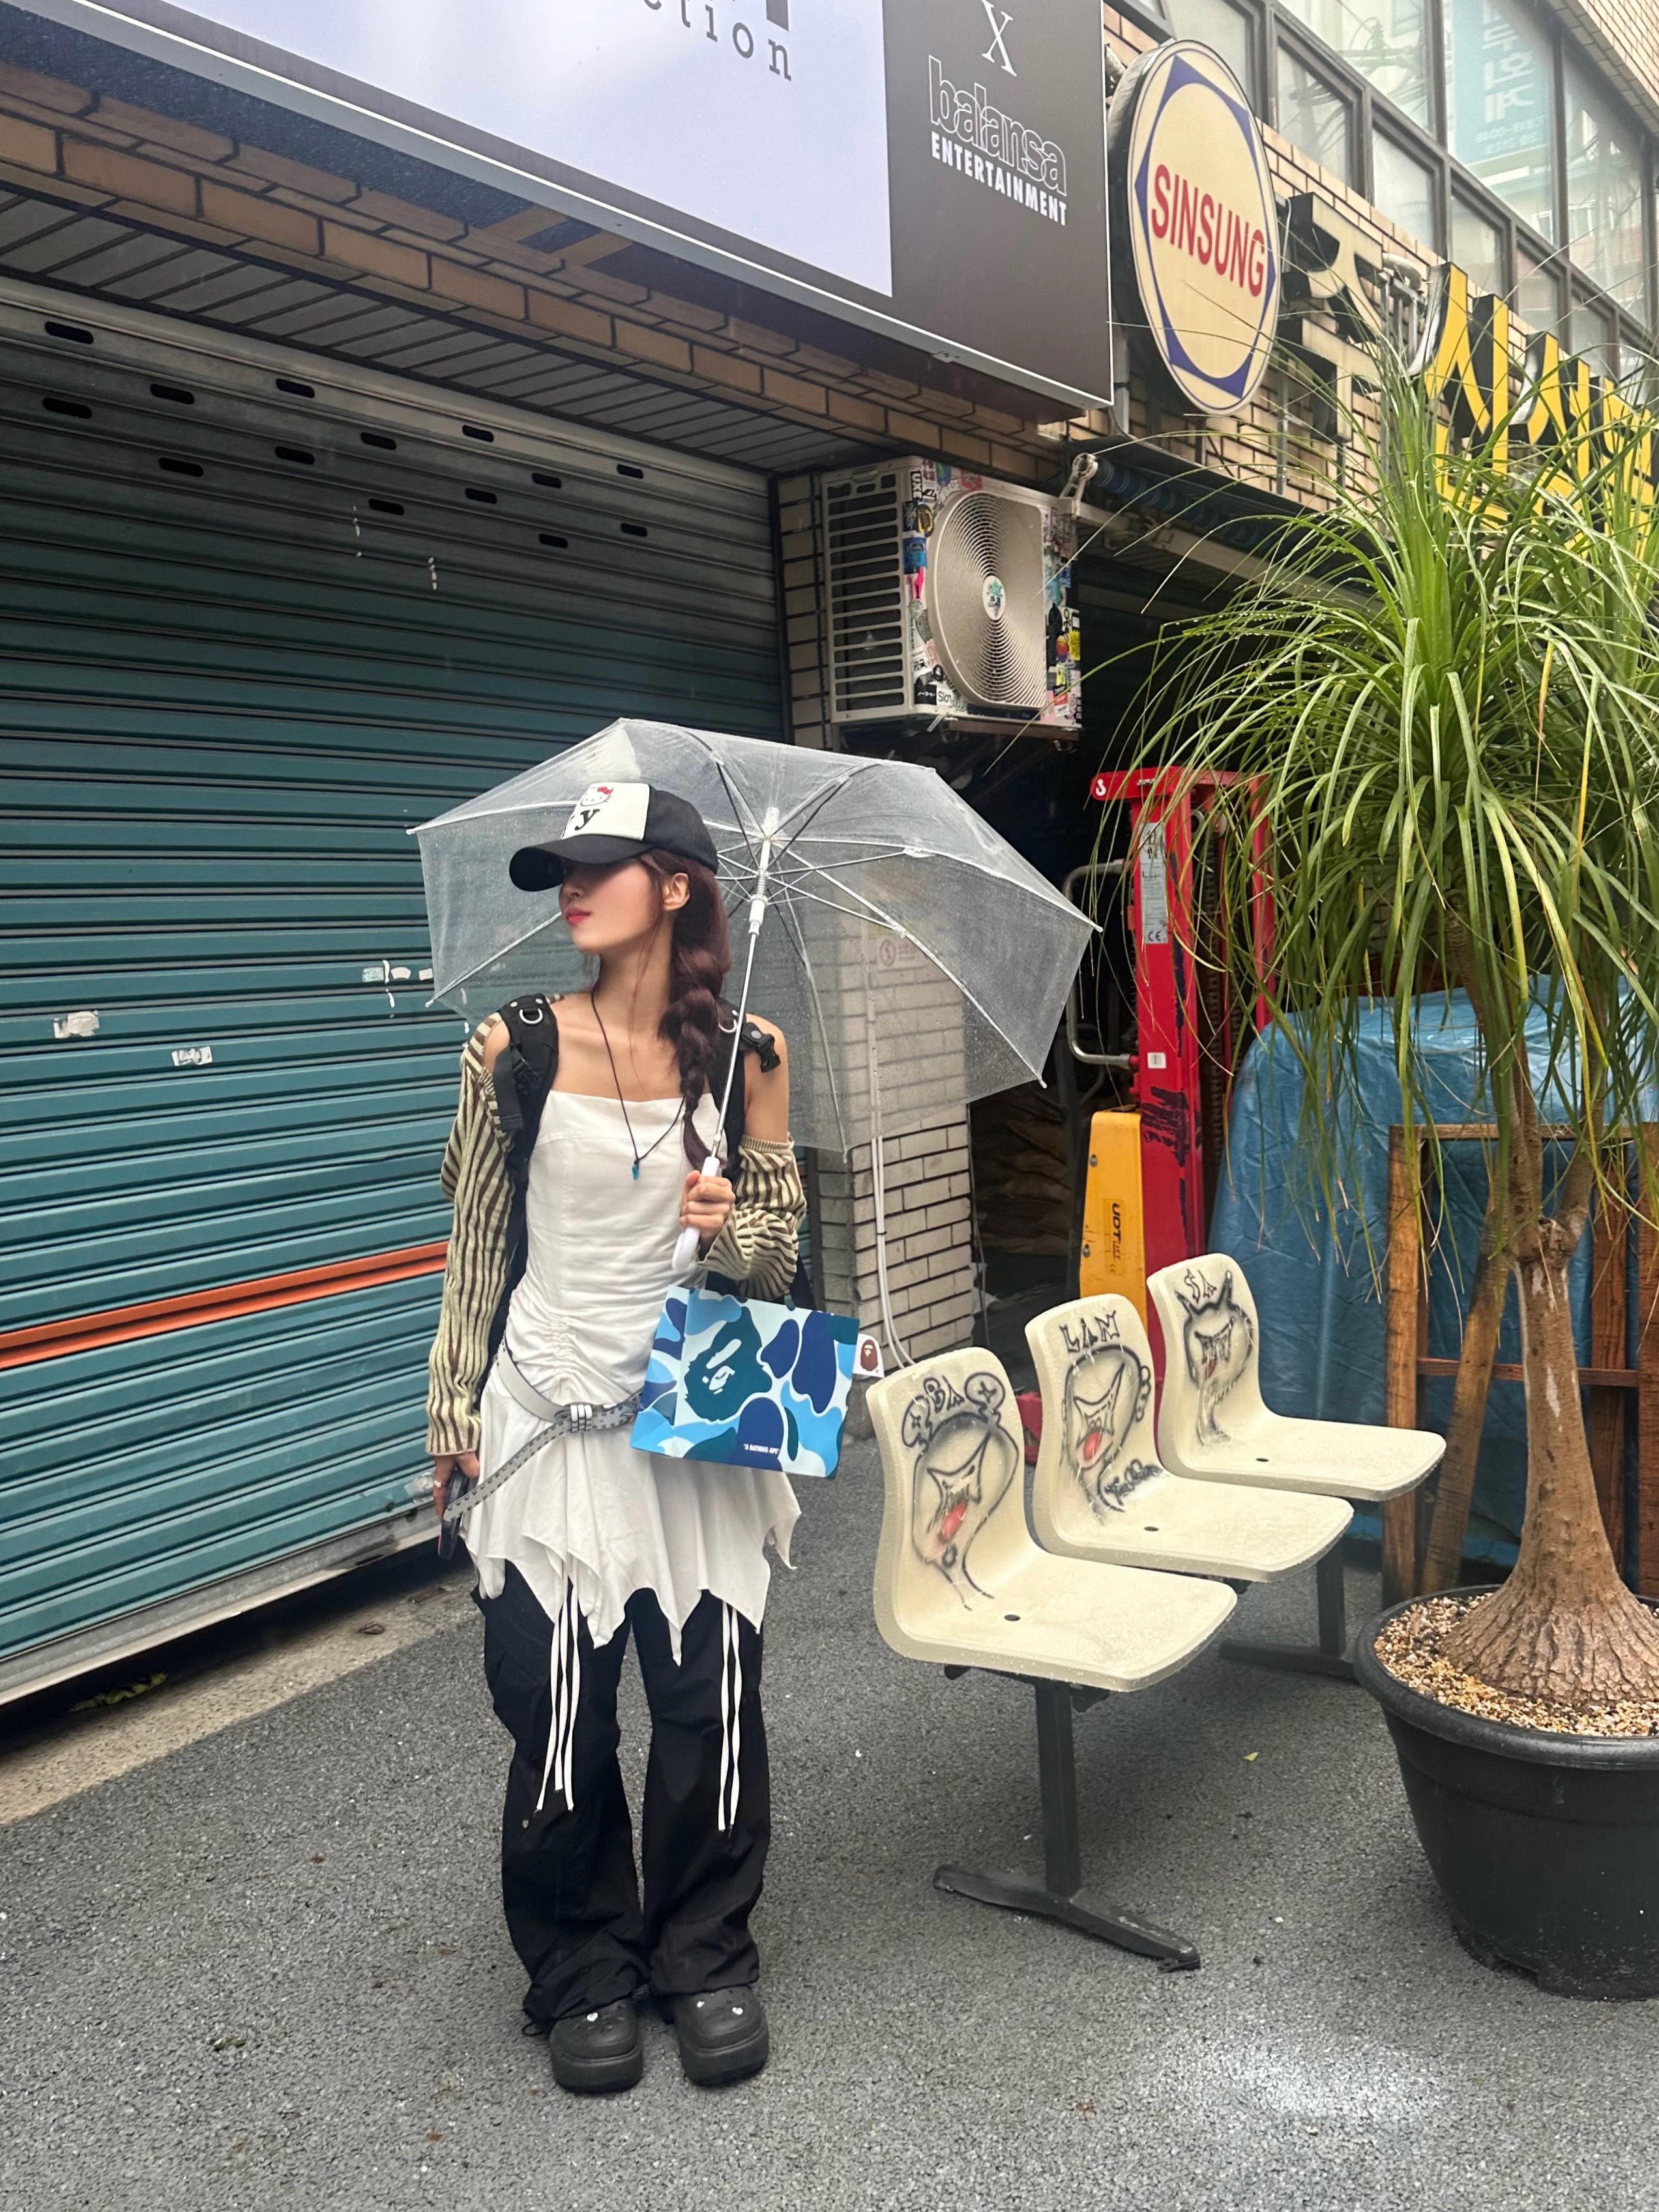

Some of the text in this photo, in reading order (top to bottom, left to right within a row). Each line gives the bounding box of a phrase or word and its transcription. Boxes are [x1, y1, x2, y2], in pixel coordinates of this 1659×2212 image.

[644, 0, 792, 81] tion
[981, 0, 1017, 77] X
[928, 54, 1068, 196] balansa
[931, 130, 1068, 226] ENTERTAINMENT
[1151, 164, 1265, 297] SINSUNG
[1112, 1202, 1121, 1242] UDT
